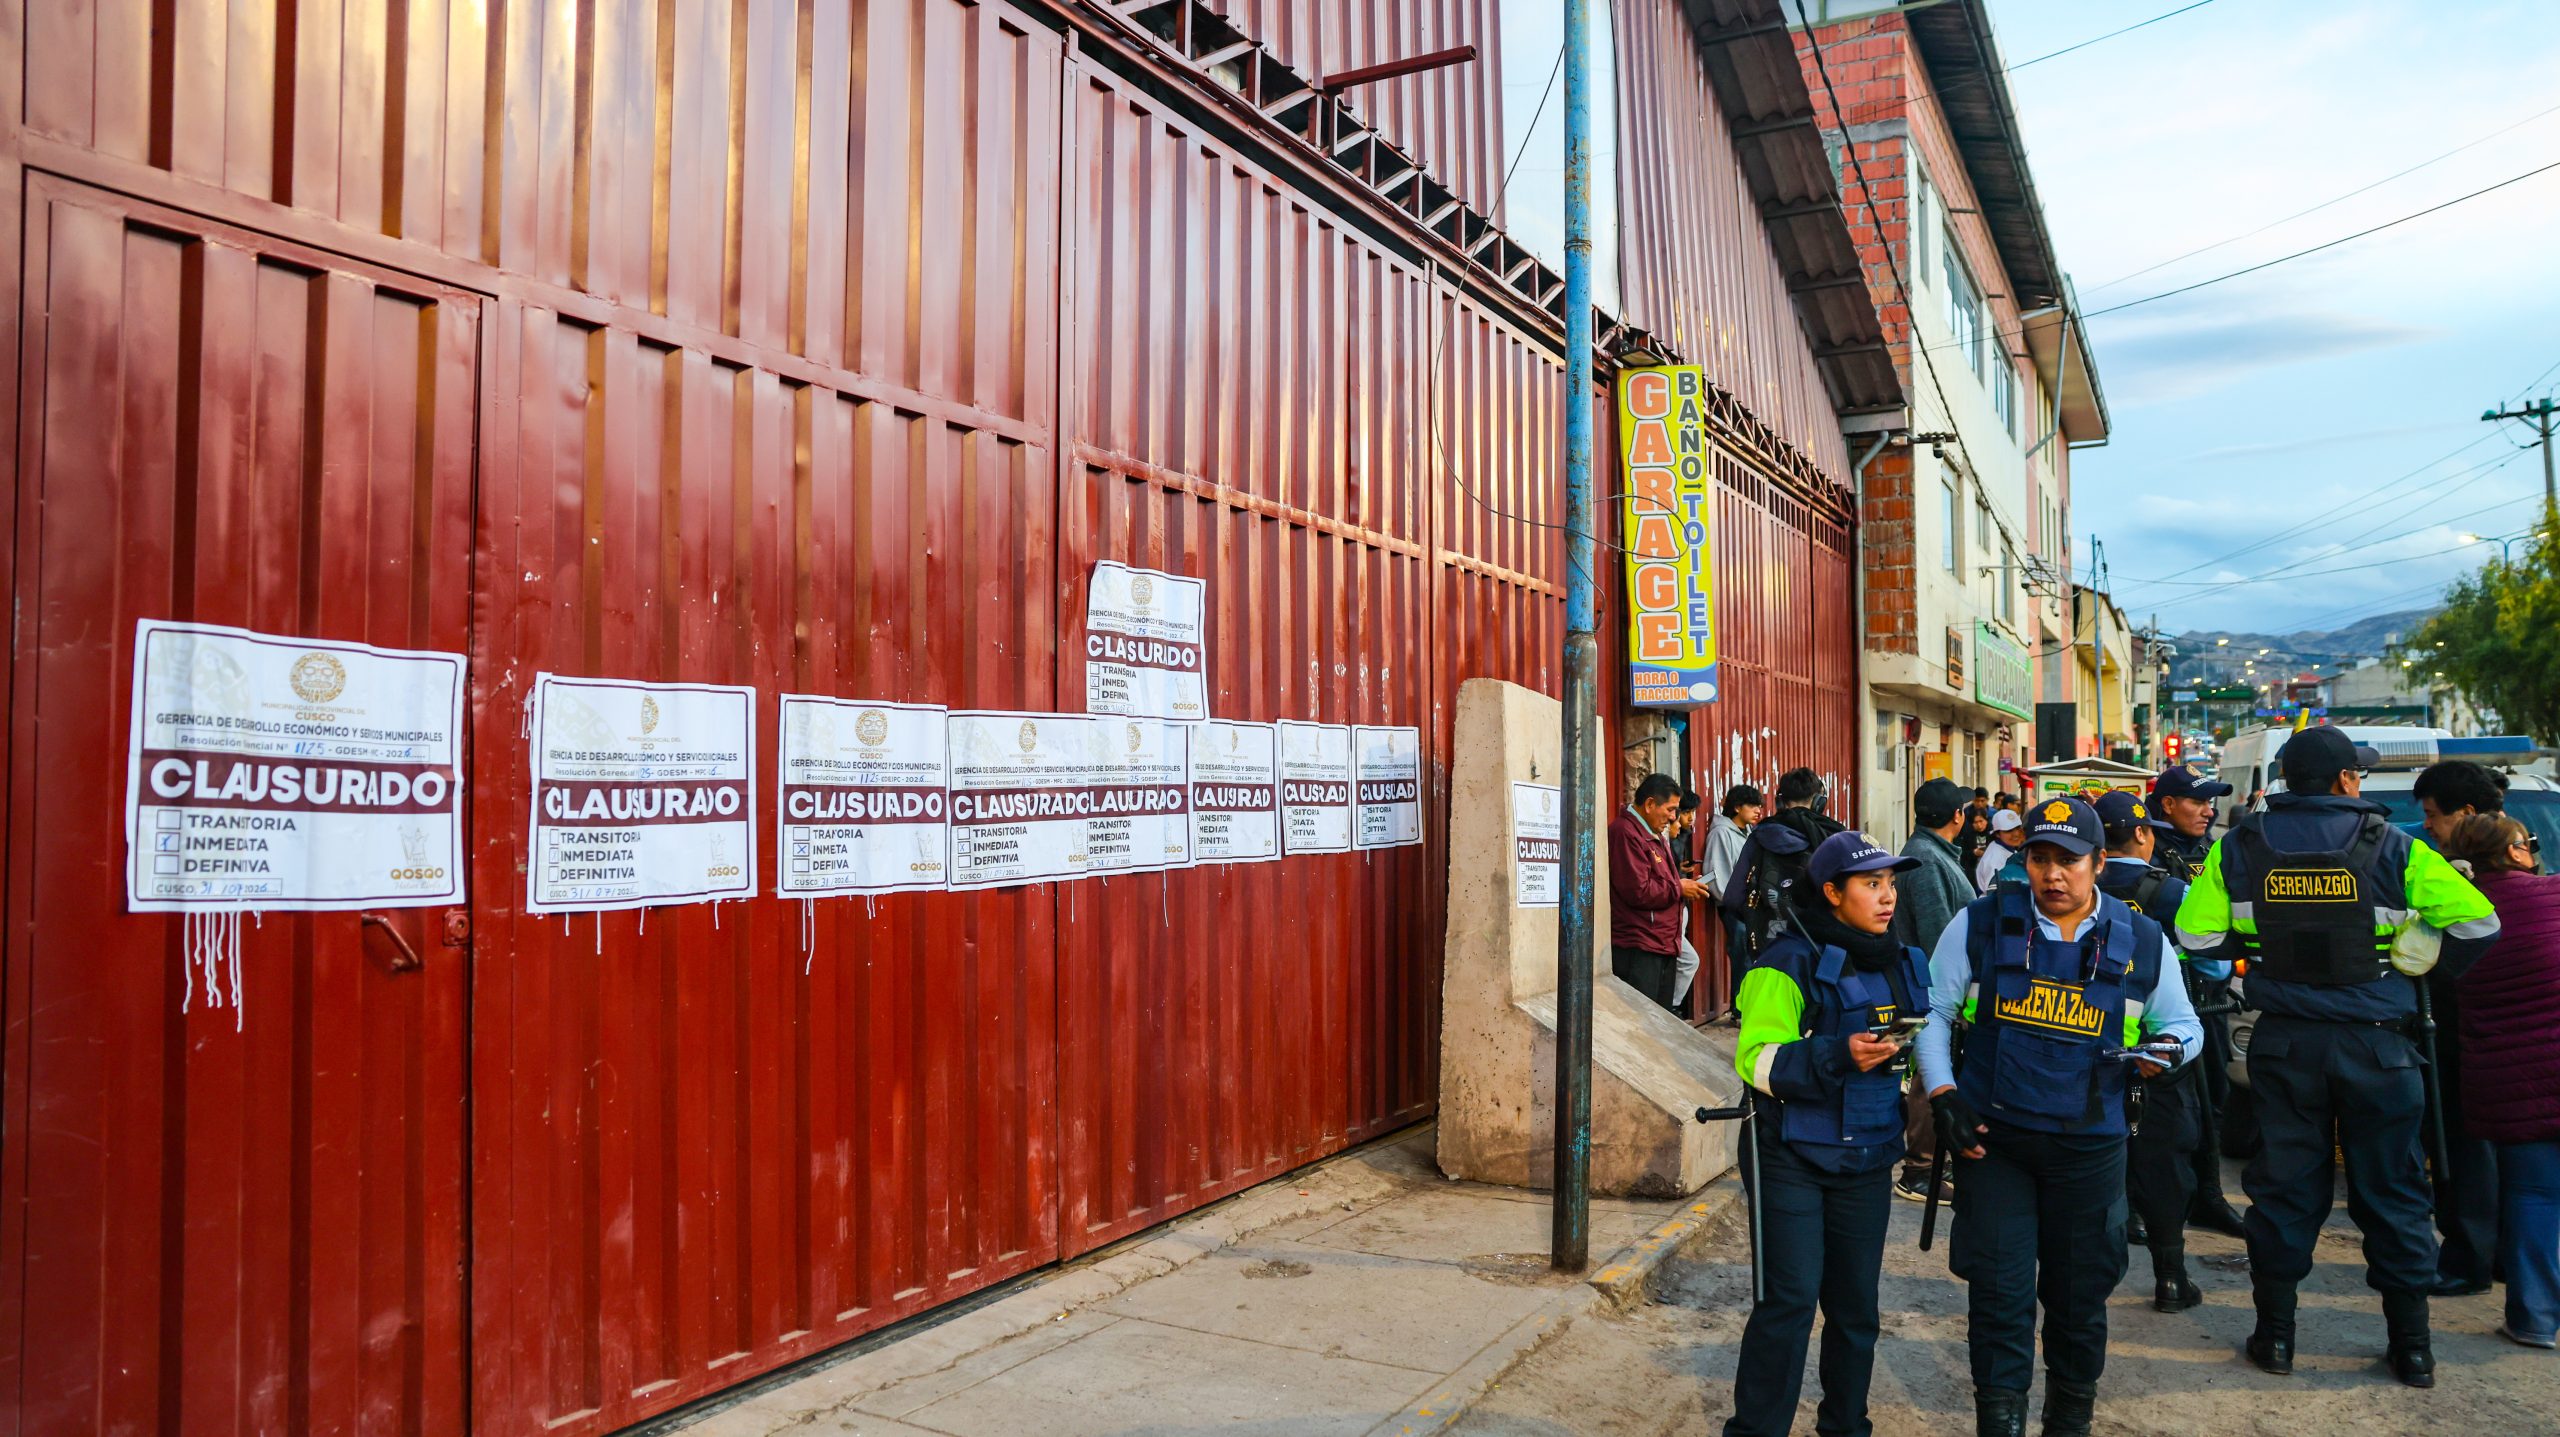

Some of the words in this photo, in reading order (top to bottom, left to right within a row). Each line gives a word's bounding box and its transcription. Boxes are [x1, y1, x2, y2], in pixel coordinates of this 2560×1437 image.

[1677, 372, 1702, 480] BAÑO
[1627, 372, 1683, 660] GARAGE
[1683, 494, 1709, 655] TOILET
[1087, 634, 1196, 668] CLASURDO
[1634, 672, 1667, 686] HORA
[1669, 671, 1679, 685] O
[1634, 687, 1689, 701] FRACCION
[295, 711, 336, 722] CUSCO
[156, 713, 213, 727] GERENCIA
[217, 716, 232, 728] DE
[284, 722, 349, 737] ECONÓMICO
[352, 728, 358, 738] Y
[385, 731, 443, 742] MUNICIPALES
[575, 751, 587, 761] DE
[668, 752, 674, 761] Y
[150, 758, 447, 806] CLAUSURADO
[187, 814, 296, 831] TRANSTORIA
[1089, 820, 1131, 830] TRANSITOR
[2034, 823, 2078, 835] SERENAZGO
[973, 826, 1028, 838] TRANSITORIA
[974, 840, 1019, 852] INMEDIATA
[1852, 846, 1888, 859] SEREN
[561, 850, 634, 862] INMEDIATA
[974, 853, 1019, 866] DEFINITIVA
[390, 867, 444, 880] QOSQO
[560, 867, 635, 880] DEFINITIVA
[910, 862, 942, 872] QOSQO
[2270, 874, 2351, 896] SERENAZGO
